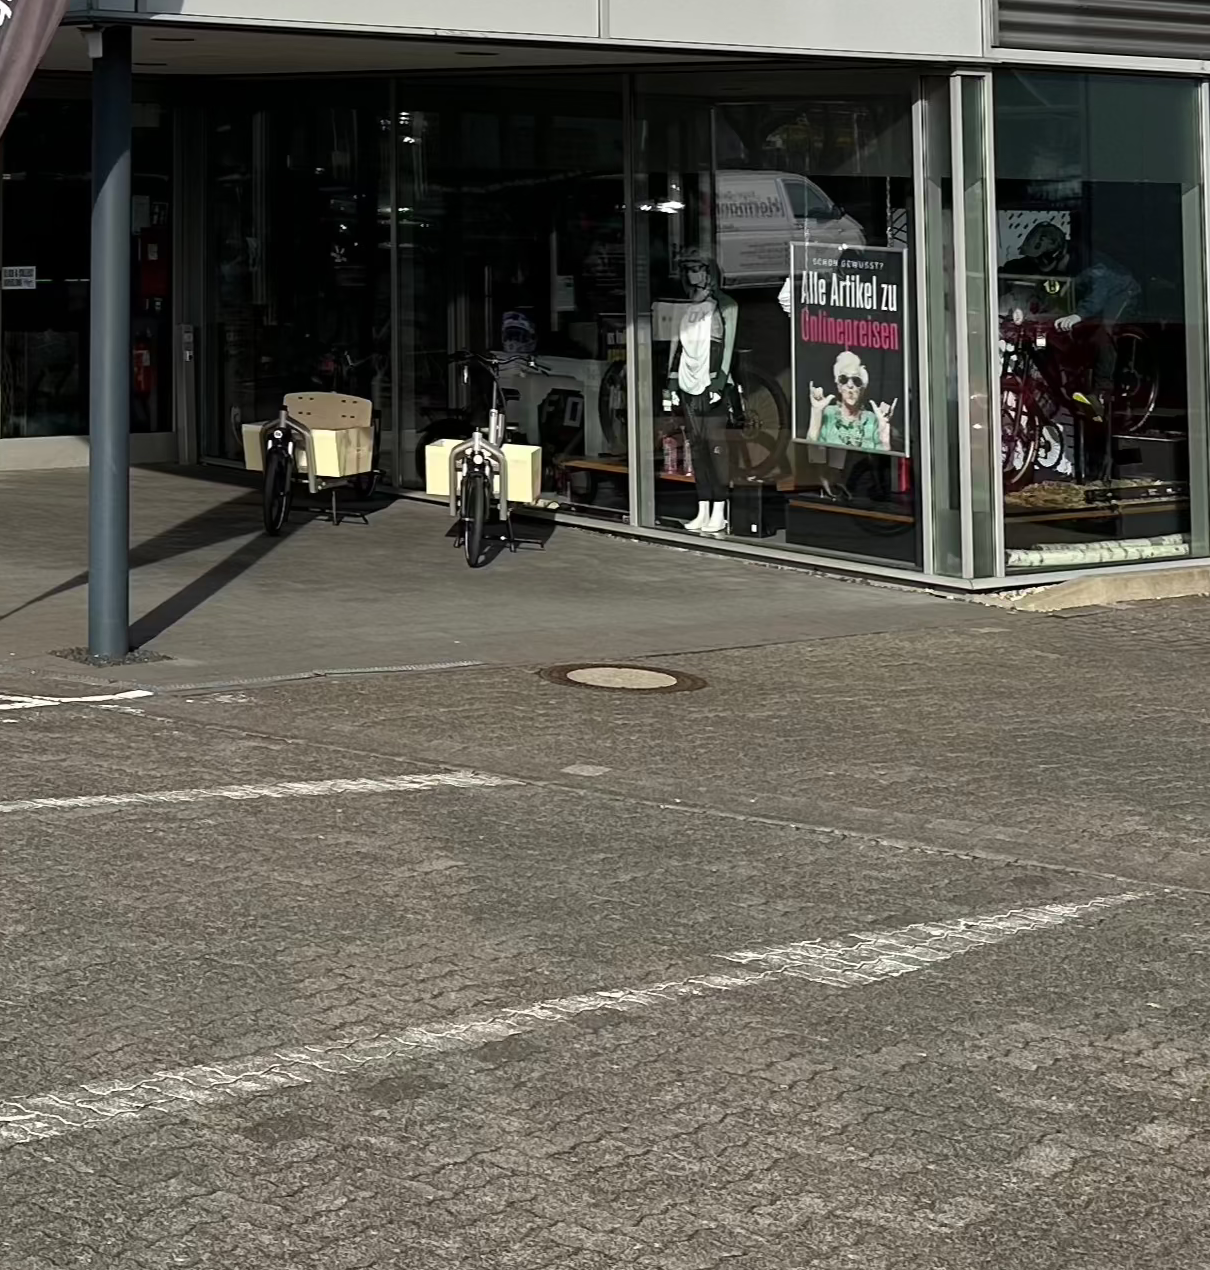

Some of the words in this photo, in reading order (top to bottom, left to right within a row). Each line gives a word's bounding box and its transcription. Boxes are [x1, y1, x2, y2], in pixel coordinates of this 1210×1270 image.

[801, 270, 827, 306] Alle
[830, 272, 877, 309] Artikel
[880, 283, 897, 312] zu
[801, 307, 899, 351] Onlinepreisen
